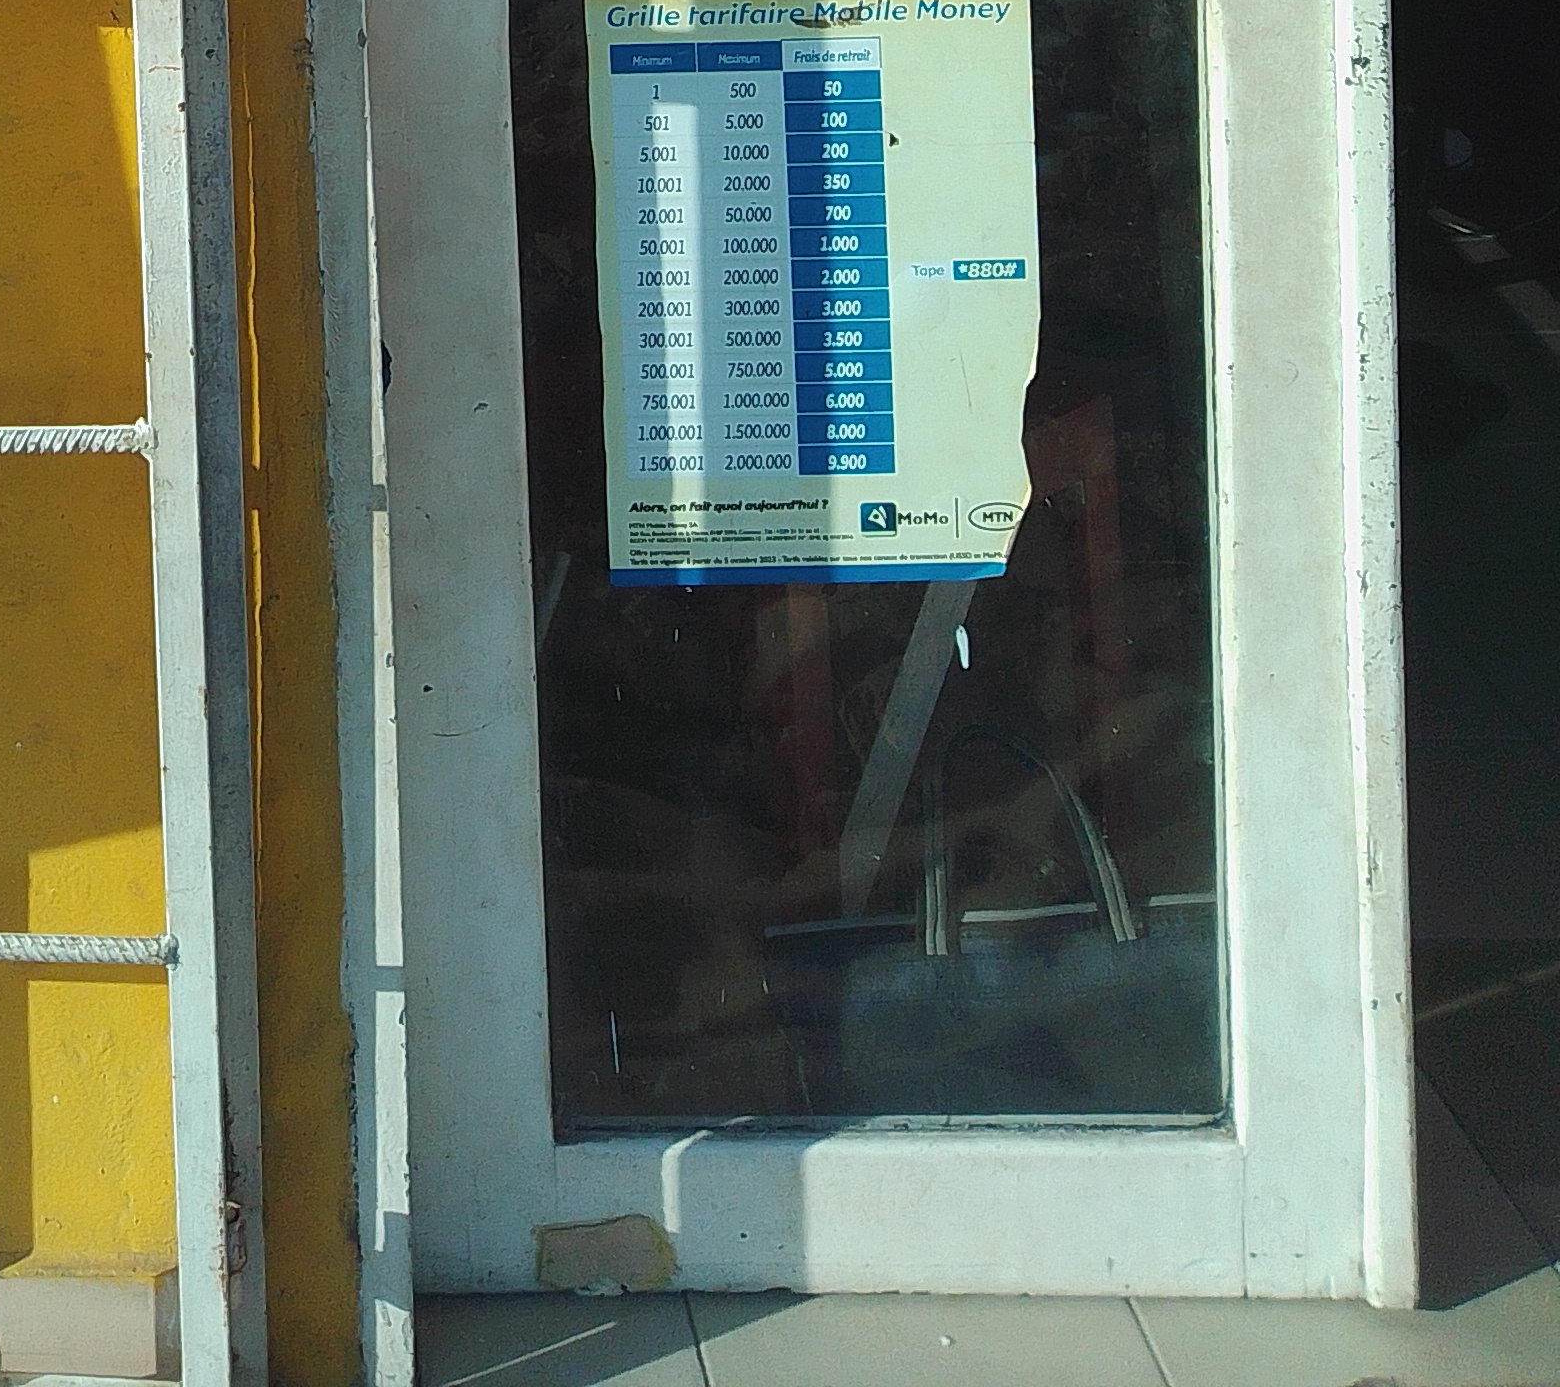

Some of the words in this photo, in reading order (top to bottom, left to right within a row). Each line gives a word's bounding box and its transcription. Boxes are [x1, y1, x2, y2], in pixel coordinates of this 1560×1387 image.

[606, 4, 681, 28] Grille
[688, 1, 805, 25] tarifaire
[815, 0, 908, 24] Mobile
[916, 0, 1012, 24] Money
[794, 49, 820, 63] Frais
[821, 49, 836, 63] de
[837, 48, 871, 62] retrait
[651, 85, 660, 99] 1
[730, 83, 757, 98] 500
[823, 81, 842, 97] 50
[644, 115, 670, 131] 501
[725, 113, 764, 129] 5.000
[821, 112, 848, 127] 100
[640, 147, 678, 162] 5.001
[723, 145, 770, 161] 10.000
[822, 143, 849, 159] 200
[637, 177, 682, 193] 10.001
[723, 176, 770, 191] 20.000
[823, 174, 850, 189] 350
[638, 209, 684, 224] 20.001
[725, 207, 772, 223] 50.000
[825, 205, 851, 221] 700
[639, 239, 686, 255] 50.001
[723, 238, 778, 254] 100.000
[820, 236, 858, 251] 1.000
[637, 271, 690, 287] 100.001
[723, 269, 778, 285] 200.000
[821, 269, 860, 285] 2.000
[911, 265, 945, 278] Tape
[638, 301, 692, 317] 200.001
[724, 300, 780, 316] 300.000
[822, 300, 861, 315] 3.000
[639, 333, 694, 348] 300.001
[725, 331, 781, 347] 500.000
[823, 331, 862, 347] 3.500
[641, 363, 694, 379] 500.001
[727, 361, 782, 378] 750.000
[824, 362, 863, 377] 5.000
[642, 395, 696, 410] 750.001
[723, 393, 790, 409] 1.000.000
[826, 393, 864, 408] 6.000
[638, 425, 703, 441] 1.000.001
[724, 423, 790, 439] 1.500.000
[826, 424, 866, 439] 8.000
[639, 455, 704, 471] 1.500.001
[724, 454, 792, 471] 2.000.000
[828, 454, 866, 470] 9.900
[628, 501, 668, 514] Alors,
[669, 503, 686, 512] on
[688, 500, 712, 512] fait
[714, 500, 743, 514] quoi
[897, 512, 949, 525] MoMo
[982, 511, 1014, 523] MTN
